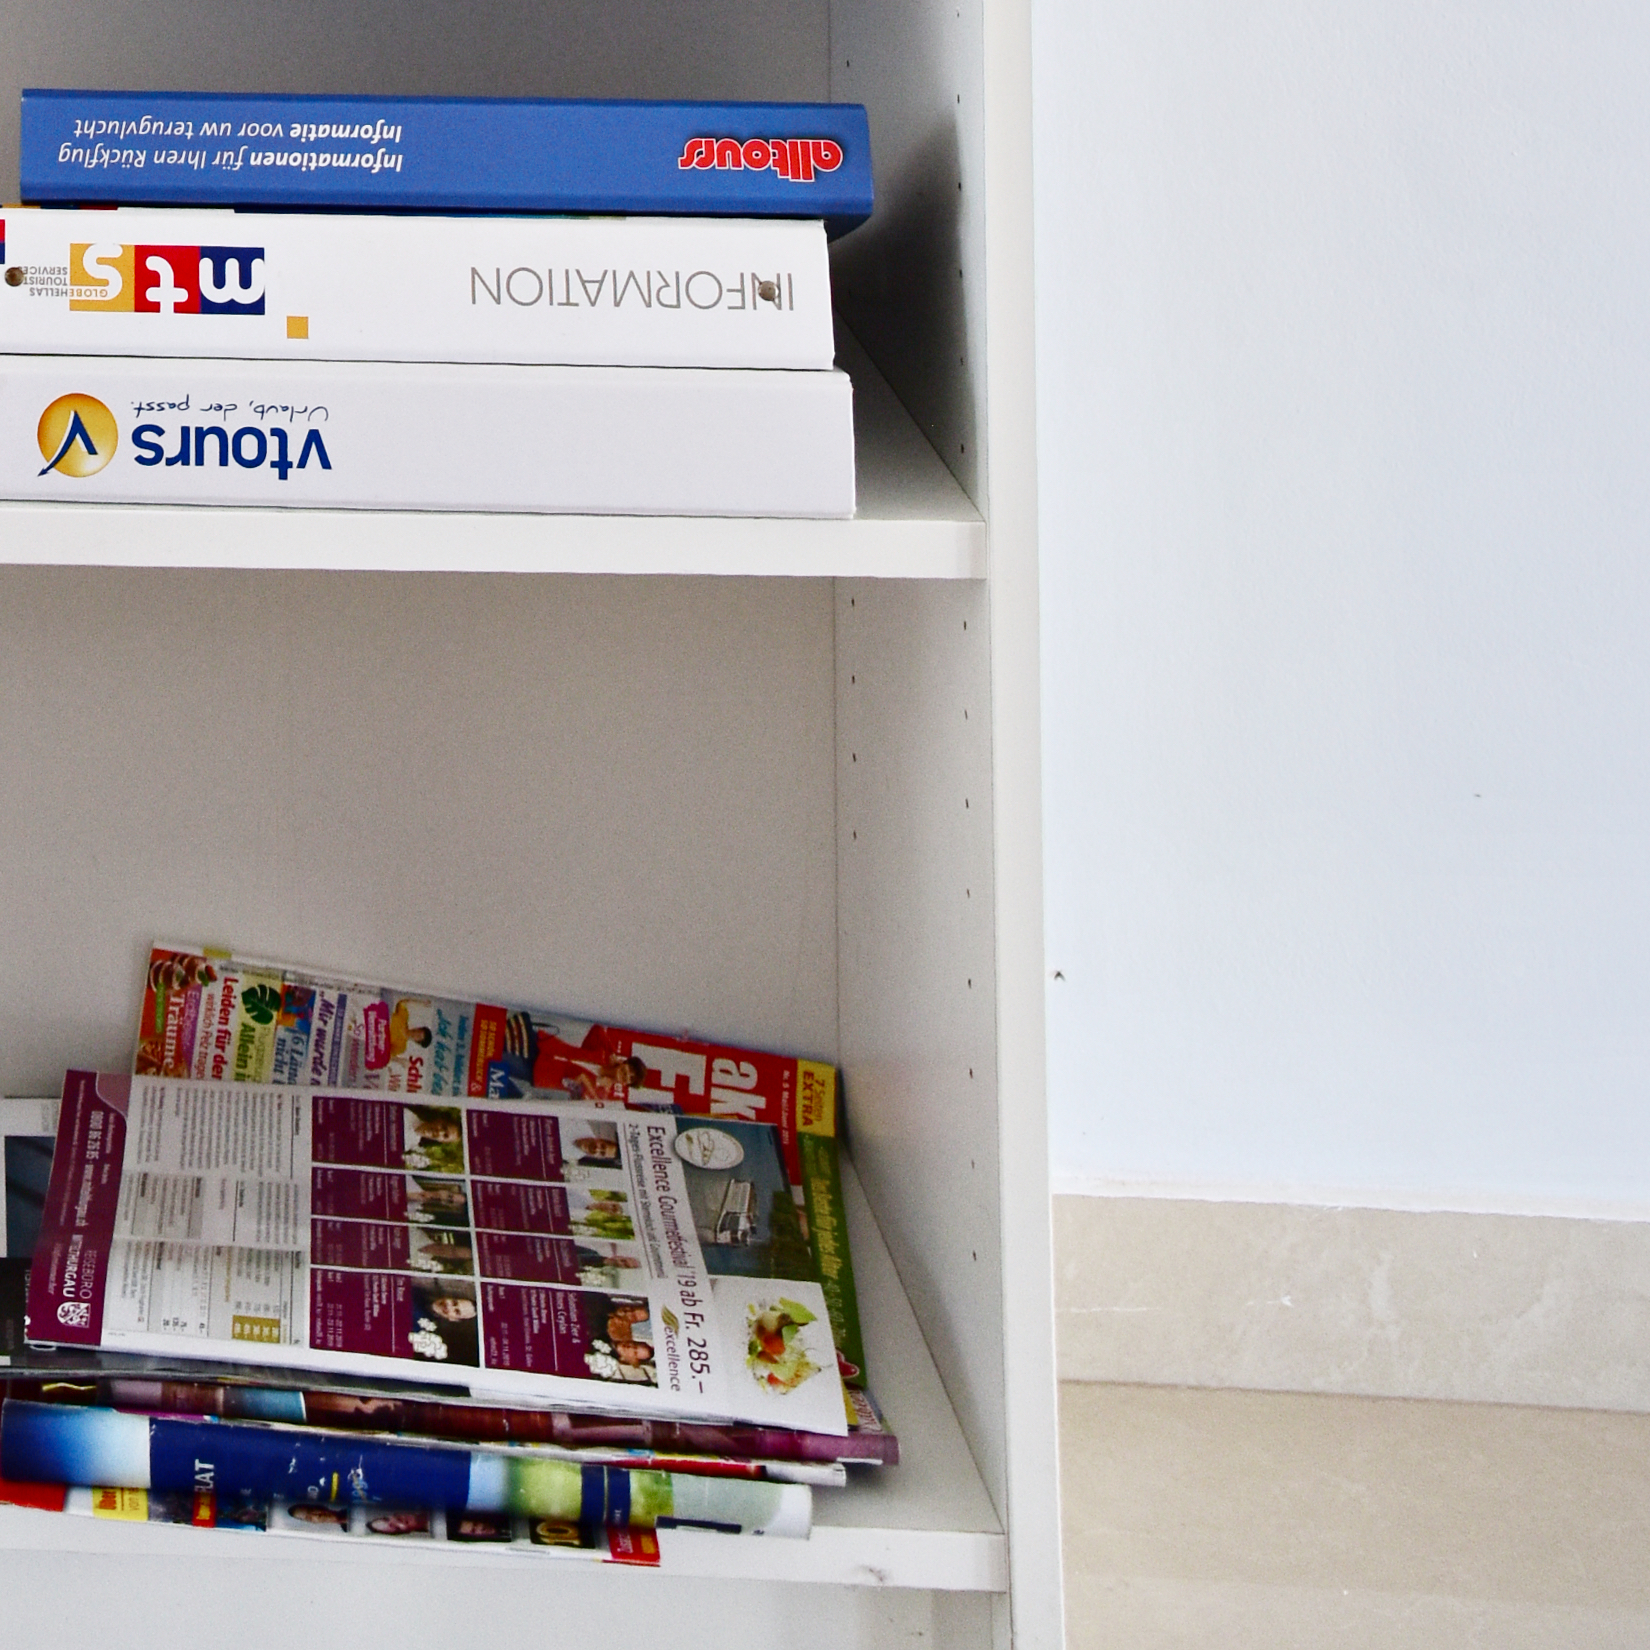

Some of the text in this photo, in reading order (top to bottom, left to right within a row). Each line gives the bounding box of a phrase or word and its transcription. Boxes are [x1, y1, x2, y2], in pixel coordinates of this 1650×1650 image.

[74, 118, 402, 143] Informatie voor uw terugvlucht
[58, 144, 403, 173] Informationen für Ihren Rückflug
[678, 138, 843, 183] alltours
[470, 266, 794, 311] INFORMATION
[130, 394, 329, 422] Urlaub, der passt.
[132, 423, 332, 480] vtours
[647, 1126, 670, 1191] Excellence
[680, 1291, 703, 1307] ab
[684, 1311, 704, 1332] Fr.
[664, 1326, 680, 1392] excellence
